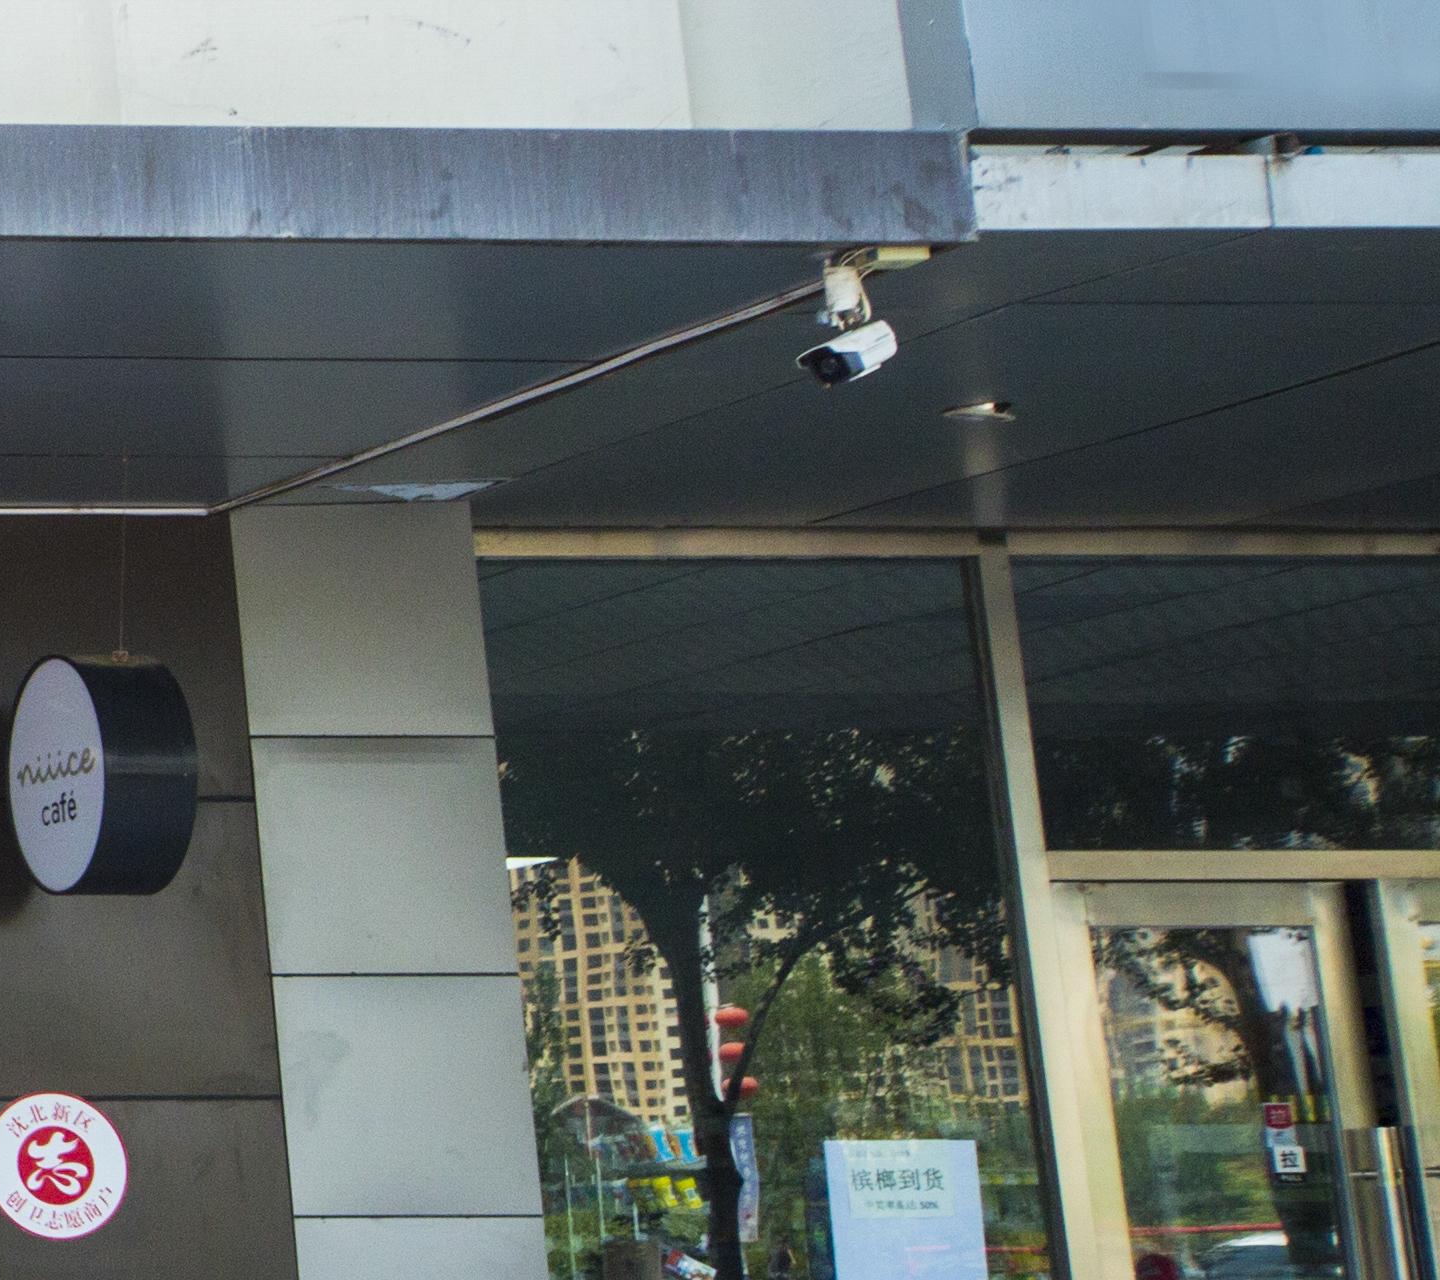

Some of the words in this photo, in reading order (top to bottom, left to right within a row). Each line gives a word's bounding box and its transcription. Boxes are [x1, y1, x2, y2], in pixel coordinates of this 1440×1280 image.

[16, 745, 97, 788] niiice
[40, 790, 78, 827] café
[6, 1101, 95, 1139] 沈北新区
[1279, 1150, 1301, 1169] 拉
[850, 1167, 945, 1192] 槟榔到货
[5, 1186, 113, 1231] 创卫志愿商户
